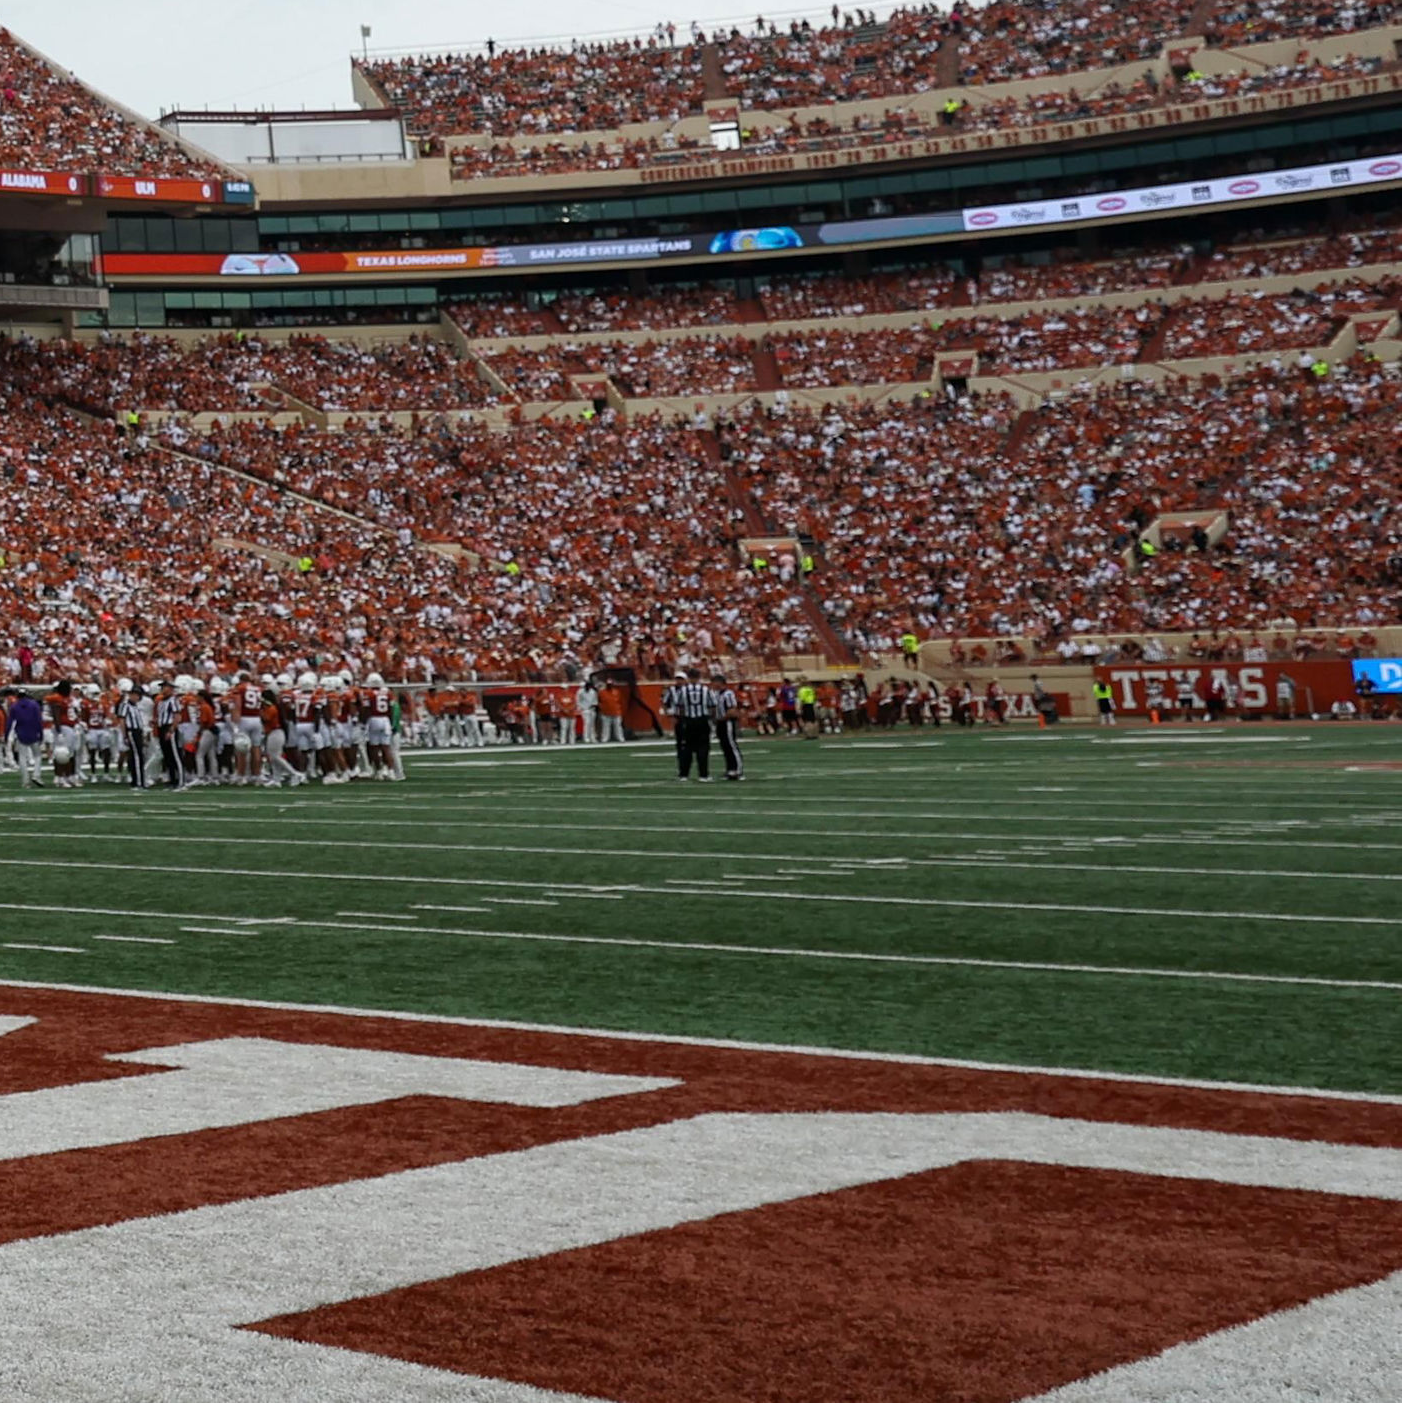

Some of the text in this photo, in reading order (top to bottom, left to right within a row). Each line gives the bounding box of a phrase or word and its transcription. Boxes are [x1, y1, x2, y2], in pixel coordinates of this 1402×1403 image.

[1, 172, 47, 189] ALABAMA
[589, 245, 626, 257] STATE
[627, 240, 691, 255] SPARTANS
[357, 255, 394, 267] TEXAS
[397, 253, 467, 265] LONGHORNS
